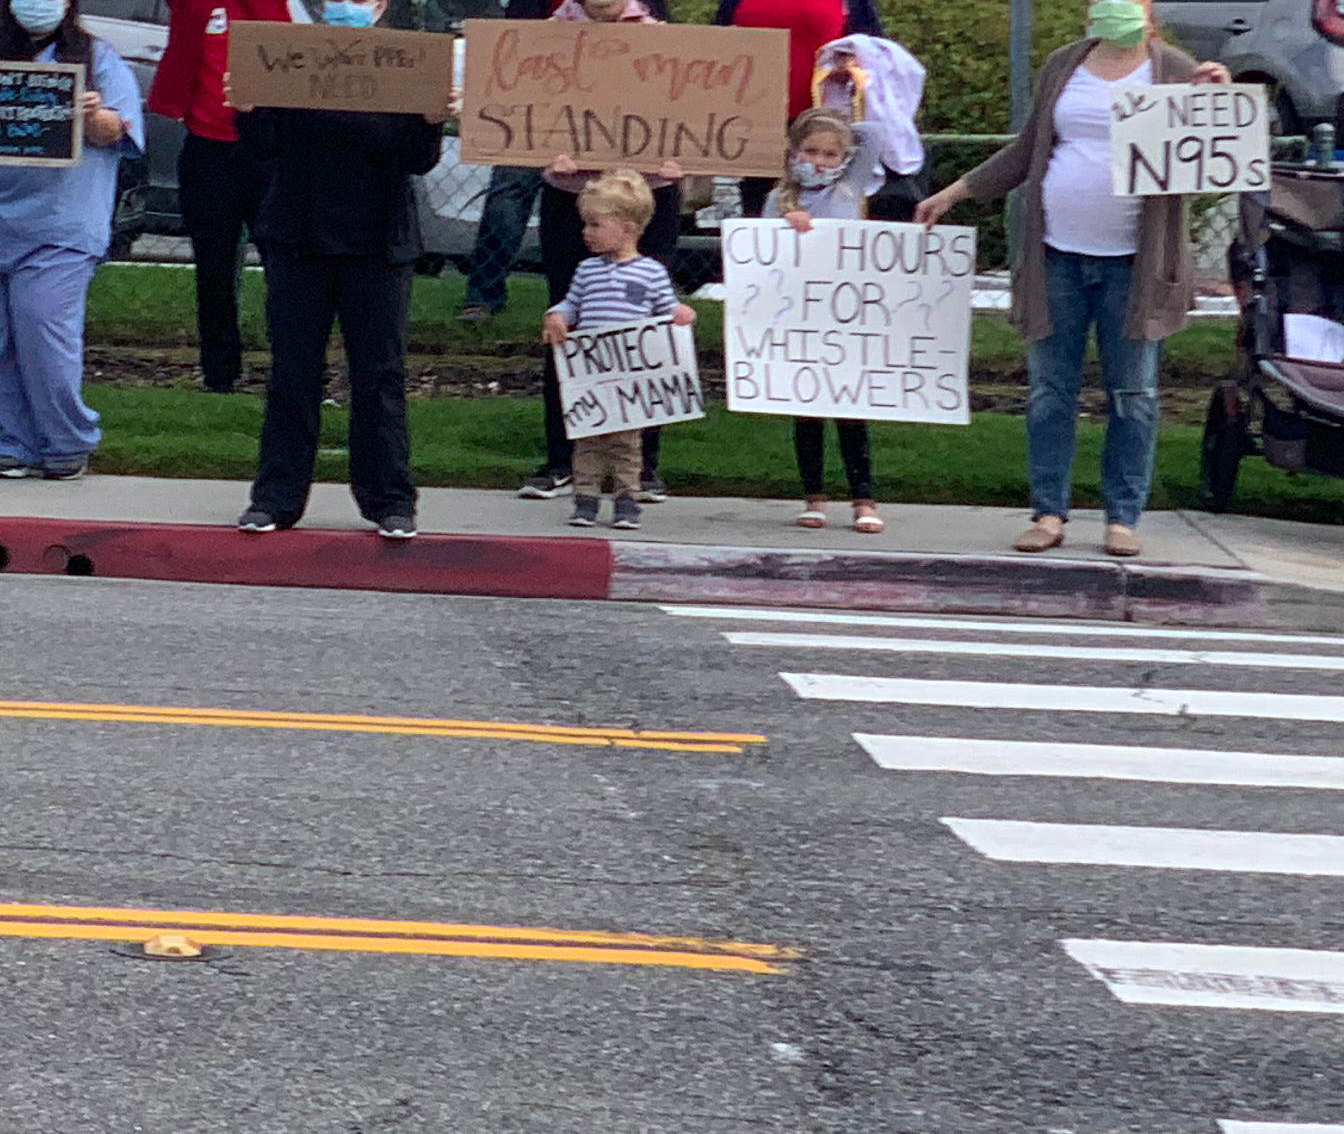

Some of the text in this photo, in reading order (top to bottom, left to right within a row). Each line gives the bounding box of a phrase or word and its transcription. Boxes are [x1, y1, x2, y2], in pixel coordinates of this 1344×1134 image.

[632, 53, 755, 106] man
[470, 103, 754, 162] STANDING
[1166, 91, 1258, 129] NEED
[726, 226, 974, 278] CUT HOURS
[802, 280, 892, 327] FOR
[562, 319, 680, 379] PROTECT
[735, 325, 957, 371] WHISTLE-
[616, 371, 706, 424] MAMA
[733, 360, 962, 411] BLOWERS
